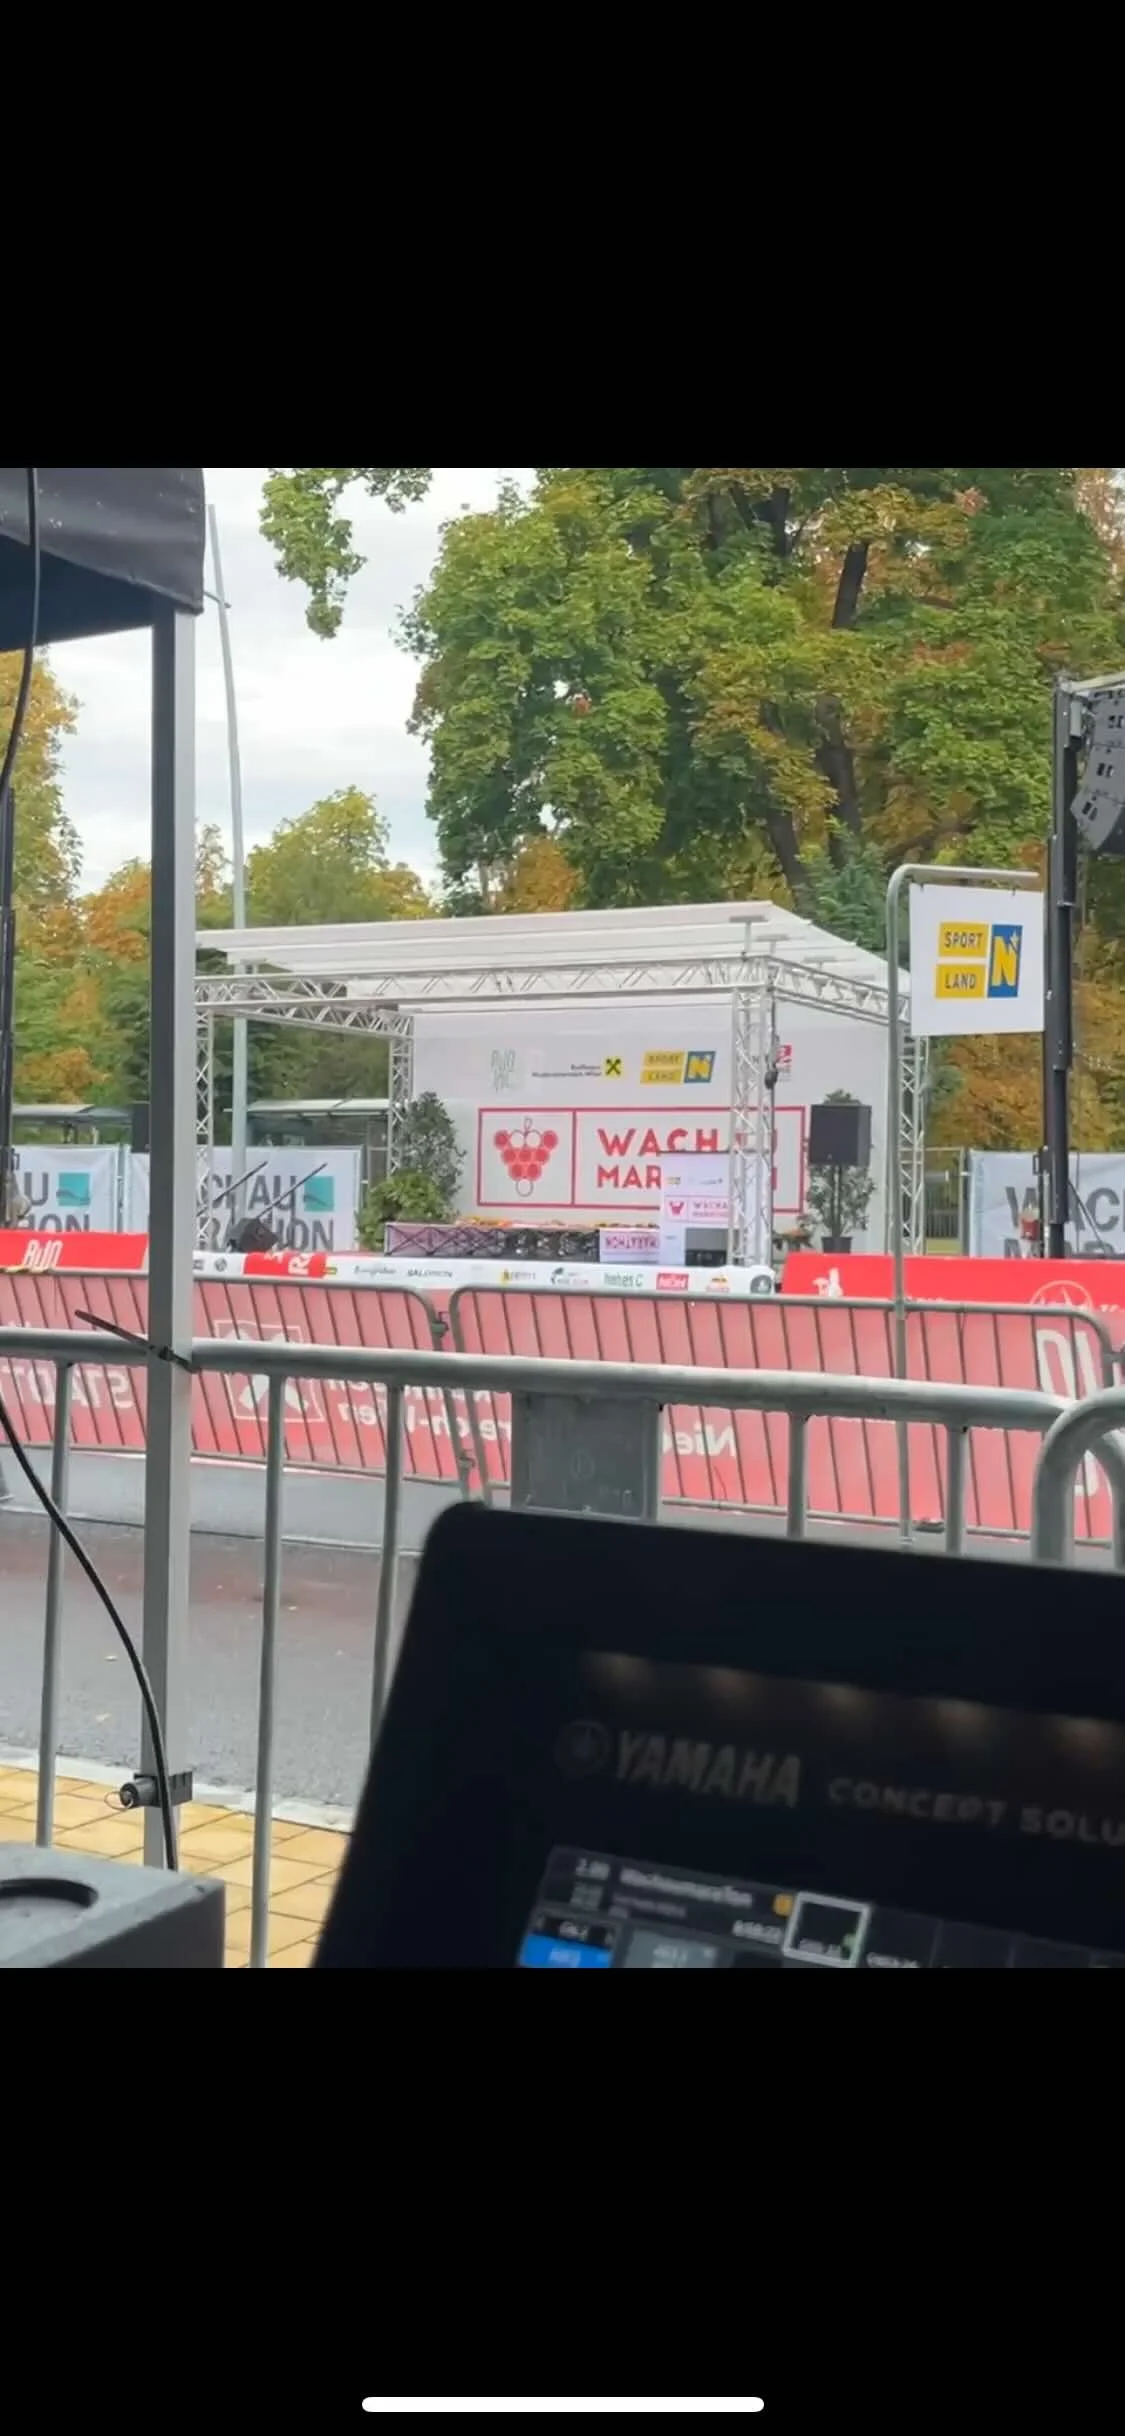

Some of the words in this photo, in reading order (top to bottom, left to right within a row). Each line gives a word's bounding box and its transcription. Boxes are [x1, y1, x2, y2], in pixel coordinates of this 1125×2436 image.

[944, 931, 984, 949] SPORT
[944, 972, 977, 990] LAND
[617, 1729, 802, 1808] YAMAHA
[828, 1776, 1008, 1826] CONCEPT
